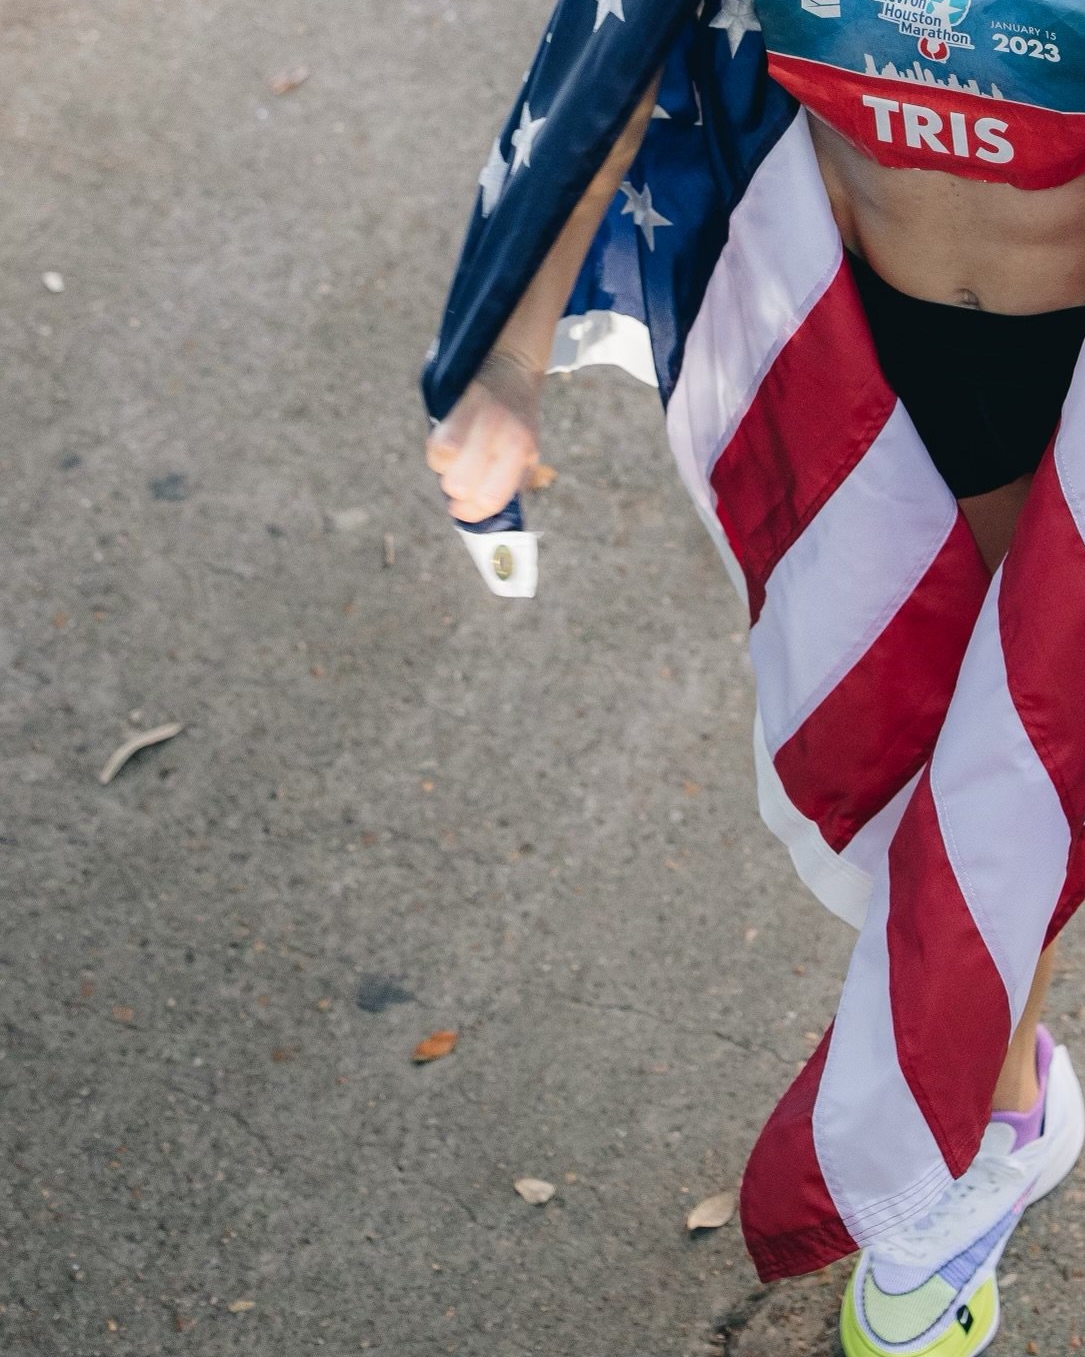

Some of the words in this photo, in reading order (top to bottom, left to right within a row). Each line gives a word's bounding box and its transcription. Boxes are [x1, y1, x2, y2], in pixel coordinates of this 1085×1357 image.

[884, 3, 942, 27] Houston
[901, 21, 969, 45] Marathon
[990, 20, 1041, 37] JANUARY
[1044, 30, 1057, 41] 15
[991, 33, 1062, 63] 2023
[861, 94, 1015, 164] TRIS
